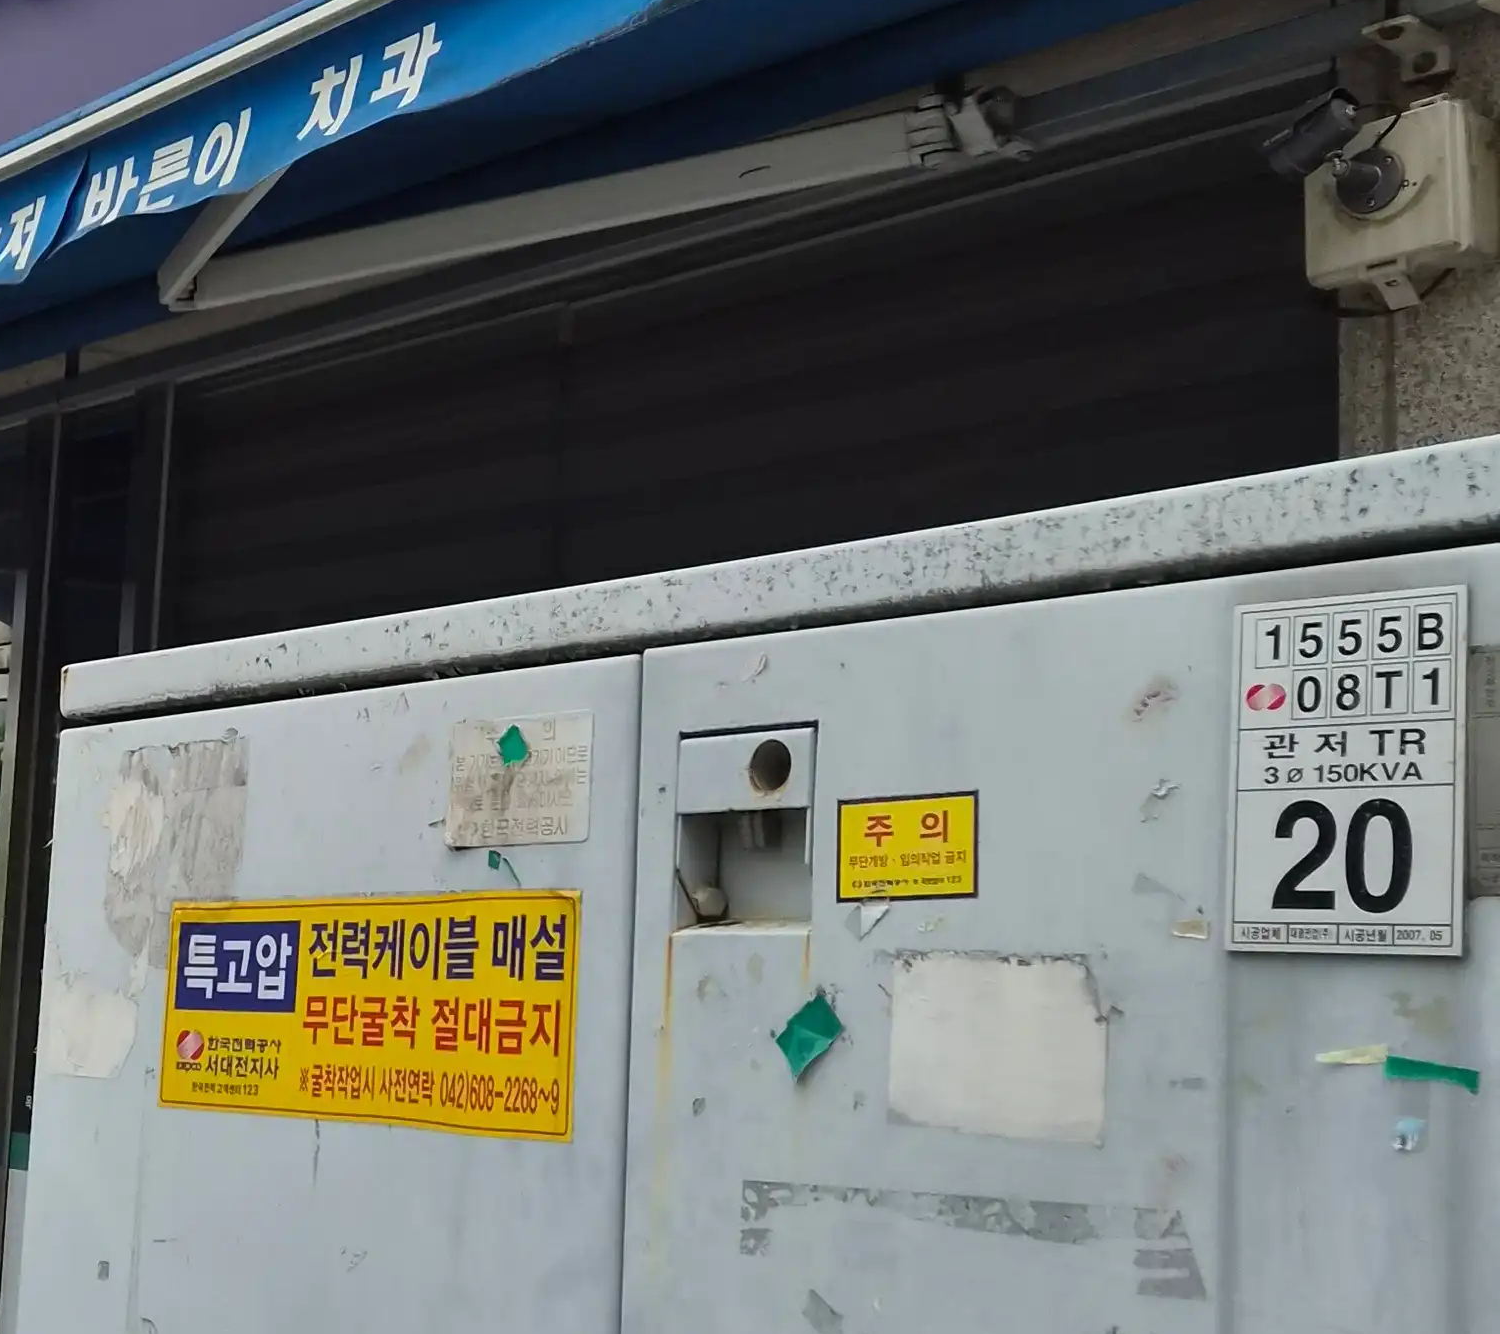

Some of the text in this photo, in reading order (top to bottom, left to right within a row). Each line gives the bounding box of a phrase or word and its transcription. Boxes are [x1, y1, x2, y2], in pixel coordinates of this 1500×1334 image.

[76, 107, 252, 232] 바른이
[1265, 611, 1445, 662] 1555B
[1296, 667, 1441, 714] 08T1
[1368, 727, 1427, 757] TR
[1314, 761, 1424, 784] 150KVA
[943, 848, 968, 865] 금지
[1271, 797, 1414, 914] 20
[183, 912, 567, 1001] 특고압 전력케이블 매설
[206, 1035, 282, 1055] 한국전력공사
[302, 994, 562, 1058] 무단굴착 절대금지
[205, 1054, 280, 1081] 서대전지사
[379, 1066, 436, 1108] 사전연락
[243, 1083, 260, 1097] 123
